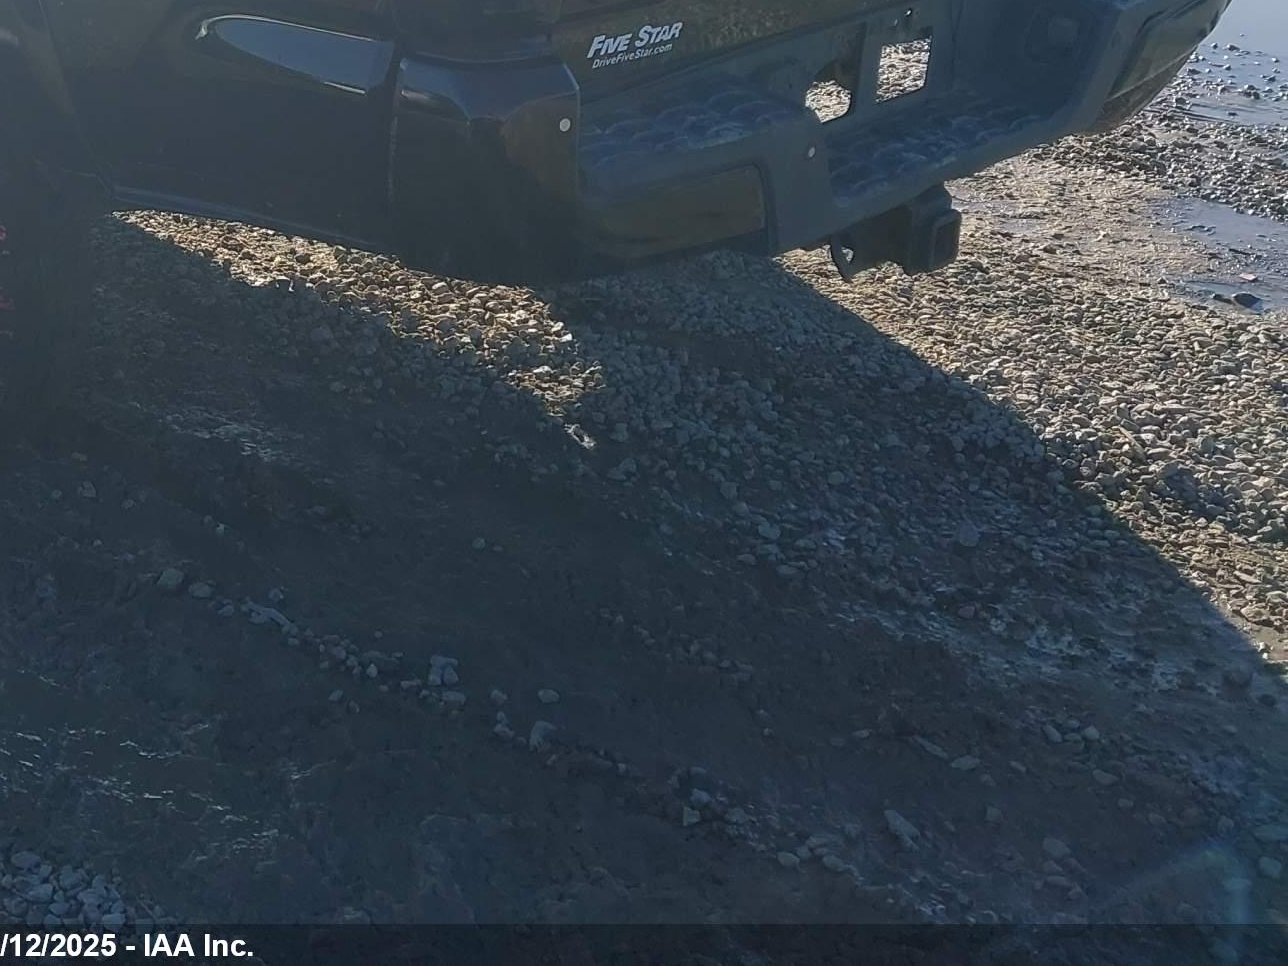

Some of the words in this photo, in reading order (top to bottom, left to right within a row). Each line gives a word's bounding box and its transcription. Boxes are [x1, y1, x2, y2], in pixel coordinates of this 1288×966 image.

[587, 34, 633, 59] FIVE
[634, 22, 683, 48] STAR
[592, 43, 673, 69] DriveFiveStar.com
